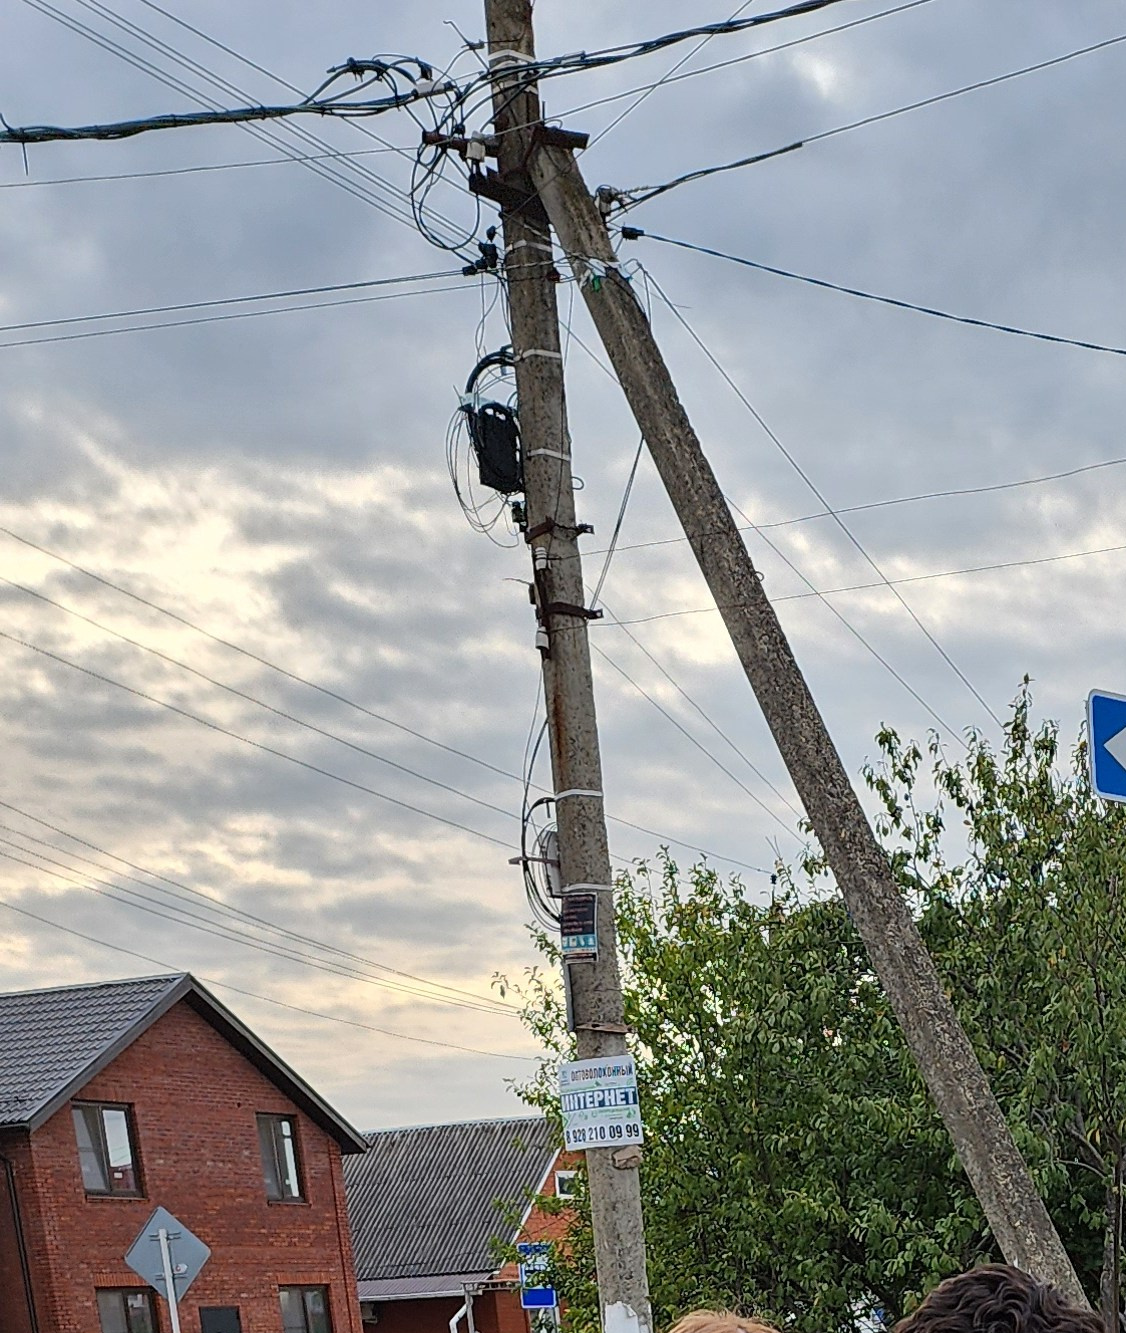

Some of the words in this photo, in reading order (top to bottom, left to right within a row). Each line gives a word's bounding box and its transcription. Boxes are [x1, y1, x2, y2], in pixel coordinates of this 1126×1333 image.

[561, 1088, 635, 1112] ИНТЕРНЕТ
[566, 1130, 571, 1144] 8
[588, 1126, 606, 1140] 210
[609, 1125, 623, 1139] 09
[625, 1123, 640, 1138] 99
